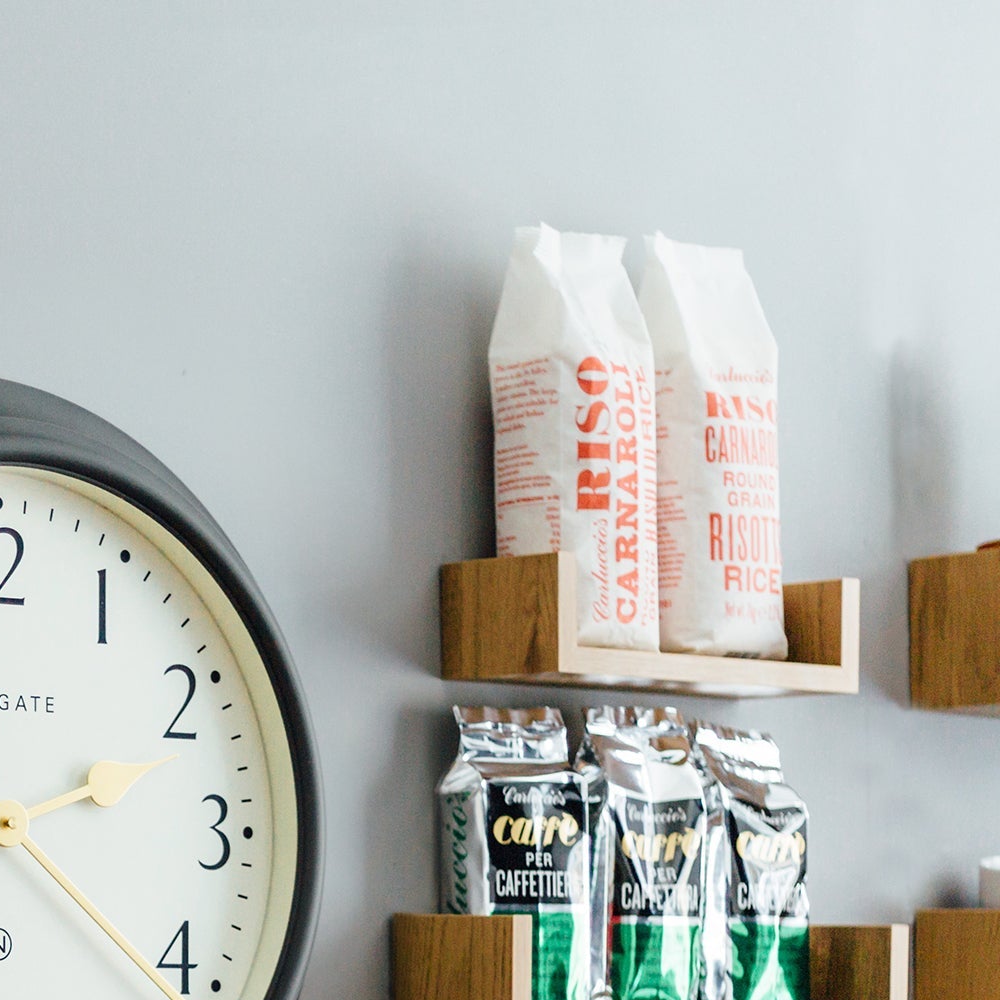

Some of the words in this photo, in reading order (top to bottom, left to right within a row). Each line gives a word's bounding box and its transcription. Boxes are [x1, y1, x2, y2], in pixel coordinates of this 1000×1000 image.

[576, 356, 611, 511] RISO
[611, 361, 638, 624] CARNAROLI
[723, 470, 776, 491] ROUND
[728, 491, 775, 509] GRAIN
[96, 568, 109, 644] 1
[592, 518, 609, 623] Carluccio's
[724, 565, 780, 595] RICE
[162, 663, 198, 740] 2
[197, 794, 231, 871] 3
[493, 812, 579, 847] caffè
[525, 852, 553, 868] PER
[495, 869, 573, 898] CAFFETTIER
[155, 919, 198, 996] 4
